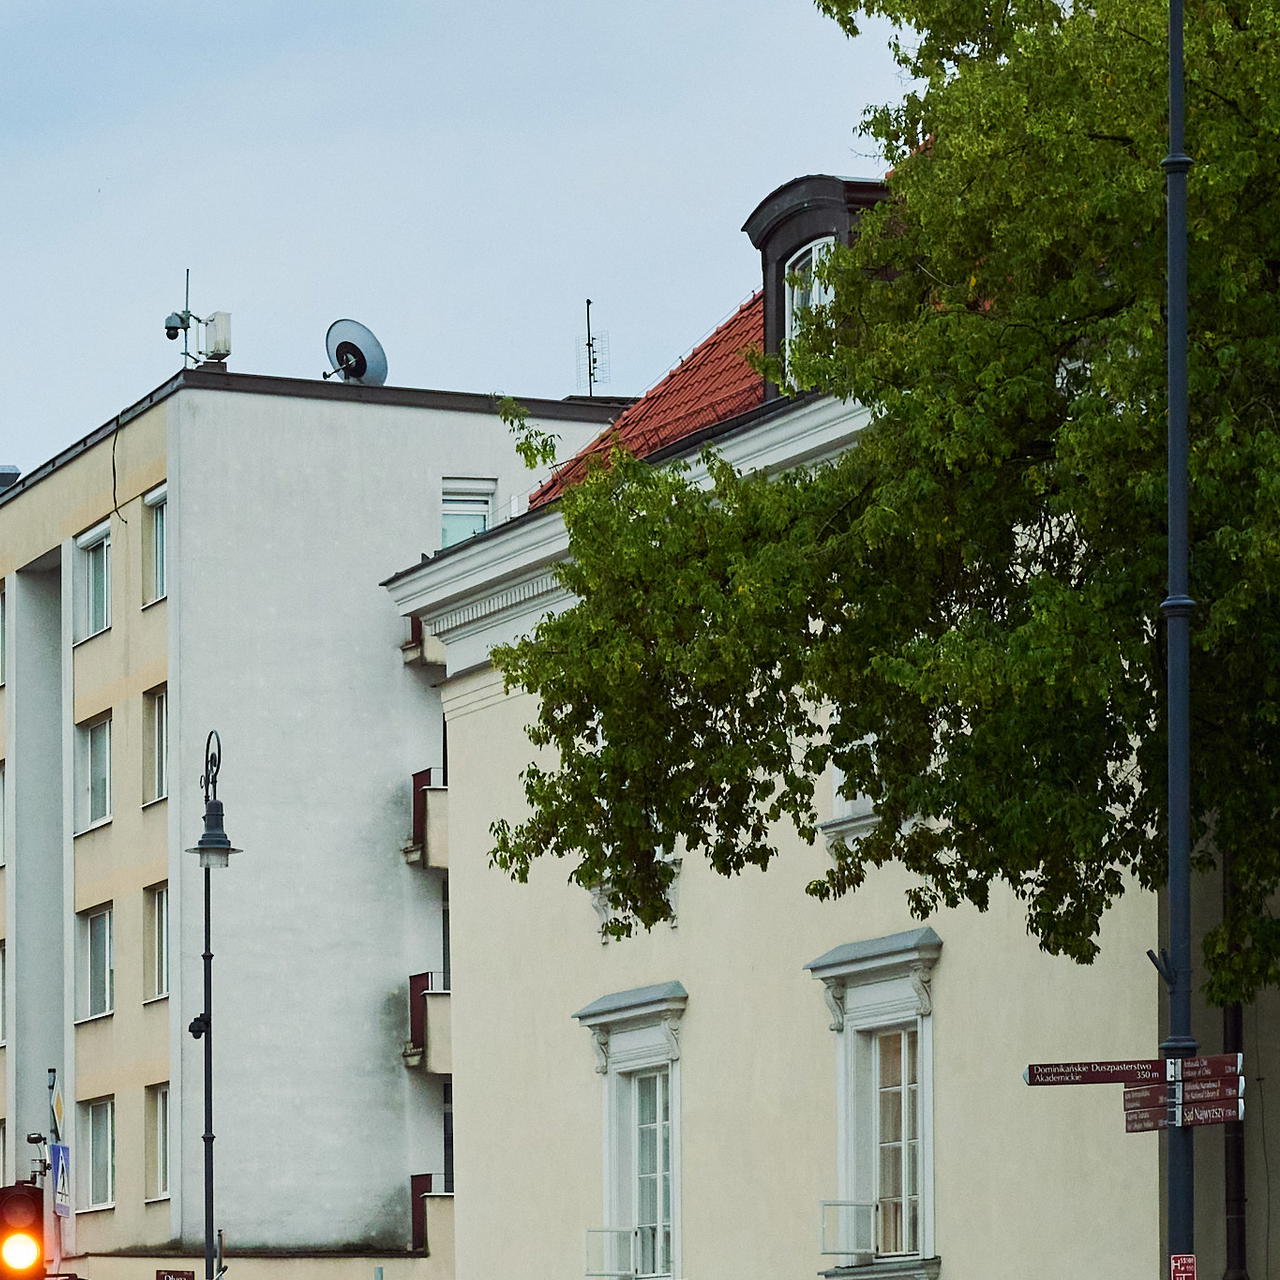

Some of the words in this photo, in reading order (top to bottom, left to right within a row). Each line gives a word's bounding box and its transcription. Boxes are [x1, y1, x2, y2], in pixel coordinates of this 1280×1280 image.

[1034, 1064, 1088, 1074] Dominikańskie
[1091, 1062, 1151, 1073] Duszpasterstwo
[1035, 1073, 1081, 1082] Akademickie
[1136, 1071, 1150, 1079] 350
[1195, 1105, 1225, 1123] Najwyższy
